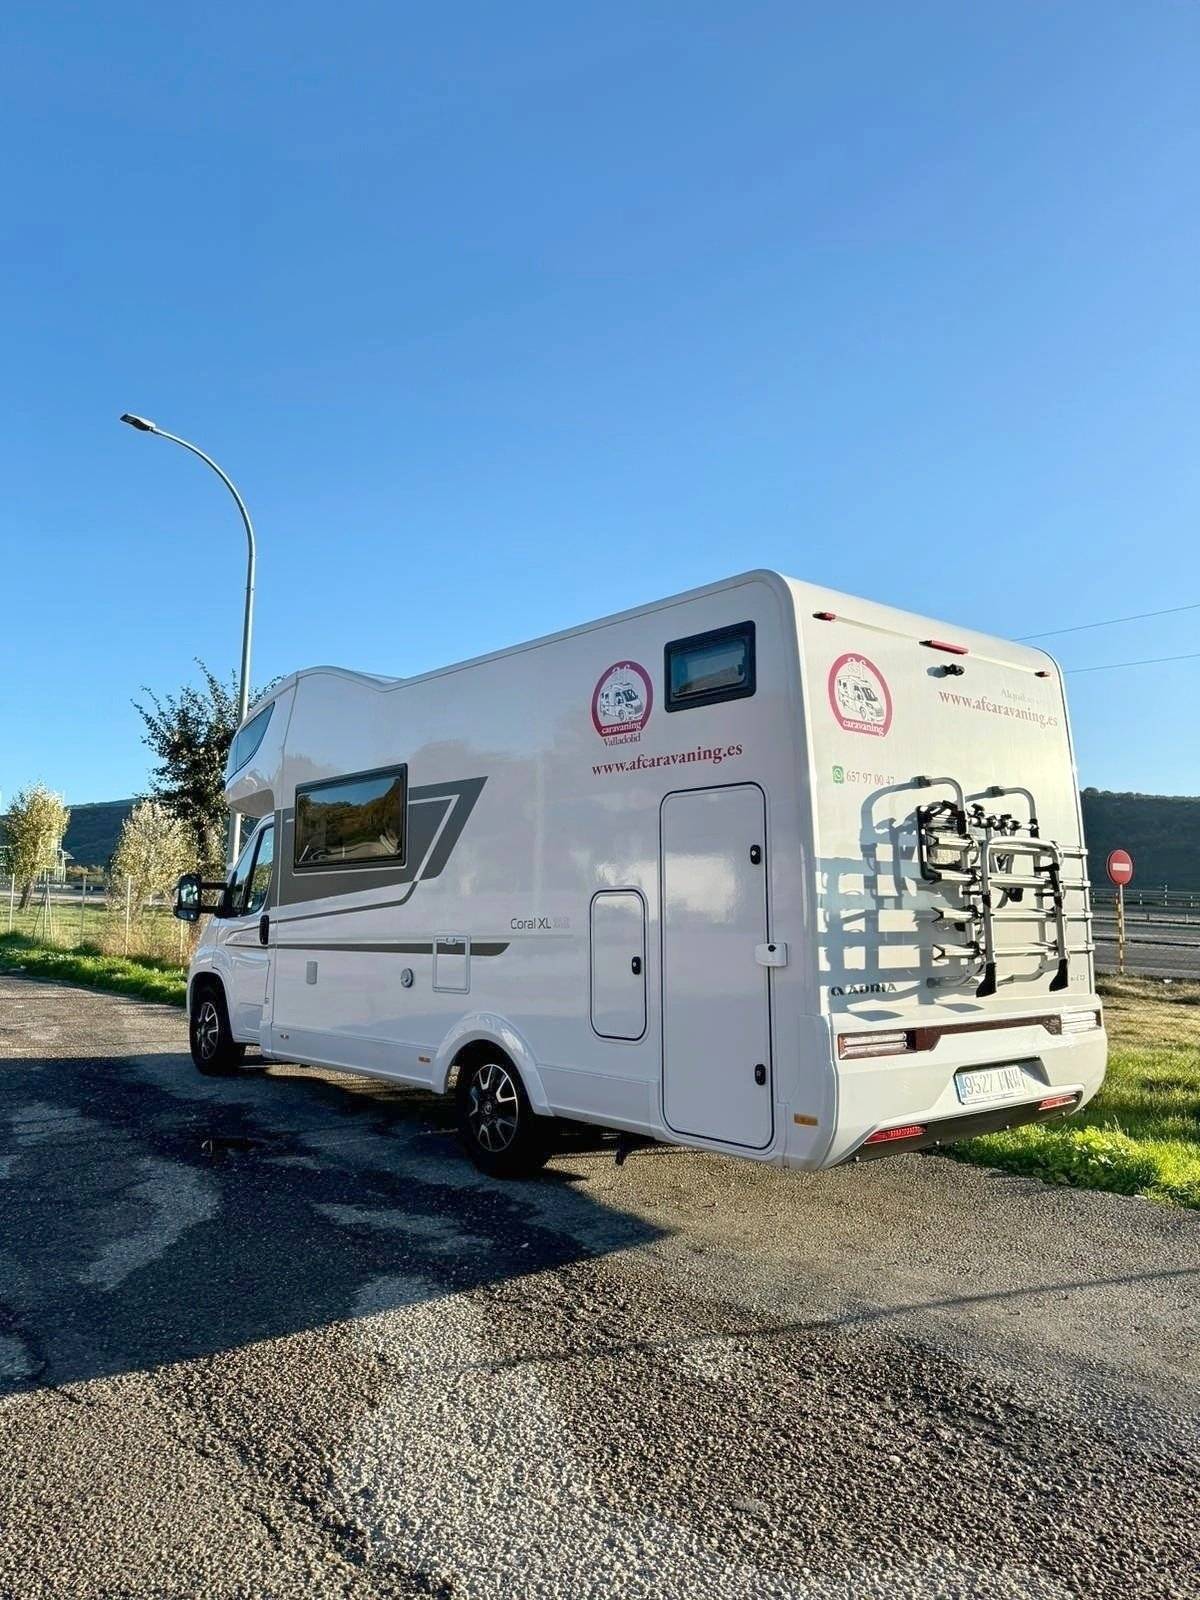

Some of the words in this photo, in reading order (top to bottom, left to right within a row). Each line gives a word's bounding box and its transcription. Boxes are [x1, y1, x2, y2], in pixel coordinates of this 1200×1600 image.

[938, 690, 1058, 729] www.afcaravaning.es
[601, 721, 642, 733] caravaning
[842, 719, 884, 736] caravaning
[603, 733, 641, 746] Valladolid
[592, 743, 743, 776] www.afcaravaning.es
[510, 917, 536, 930] Coral
[537, 917, 551, 929] XL
[848, 983, 897, 995] ADRIA
[965, 1073, 993, 1095] 9527
